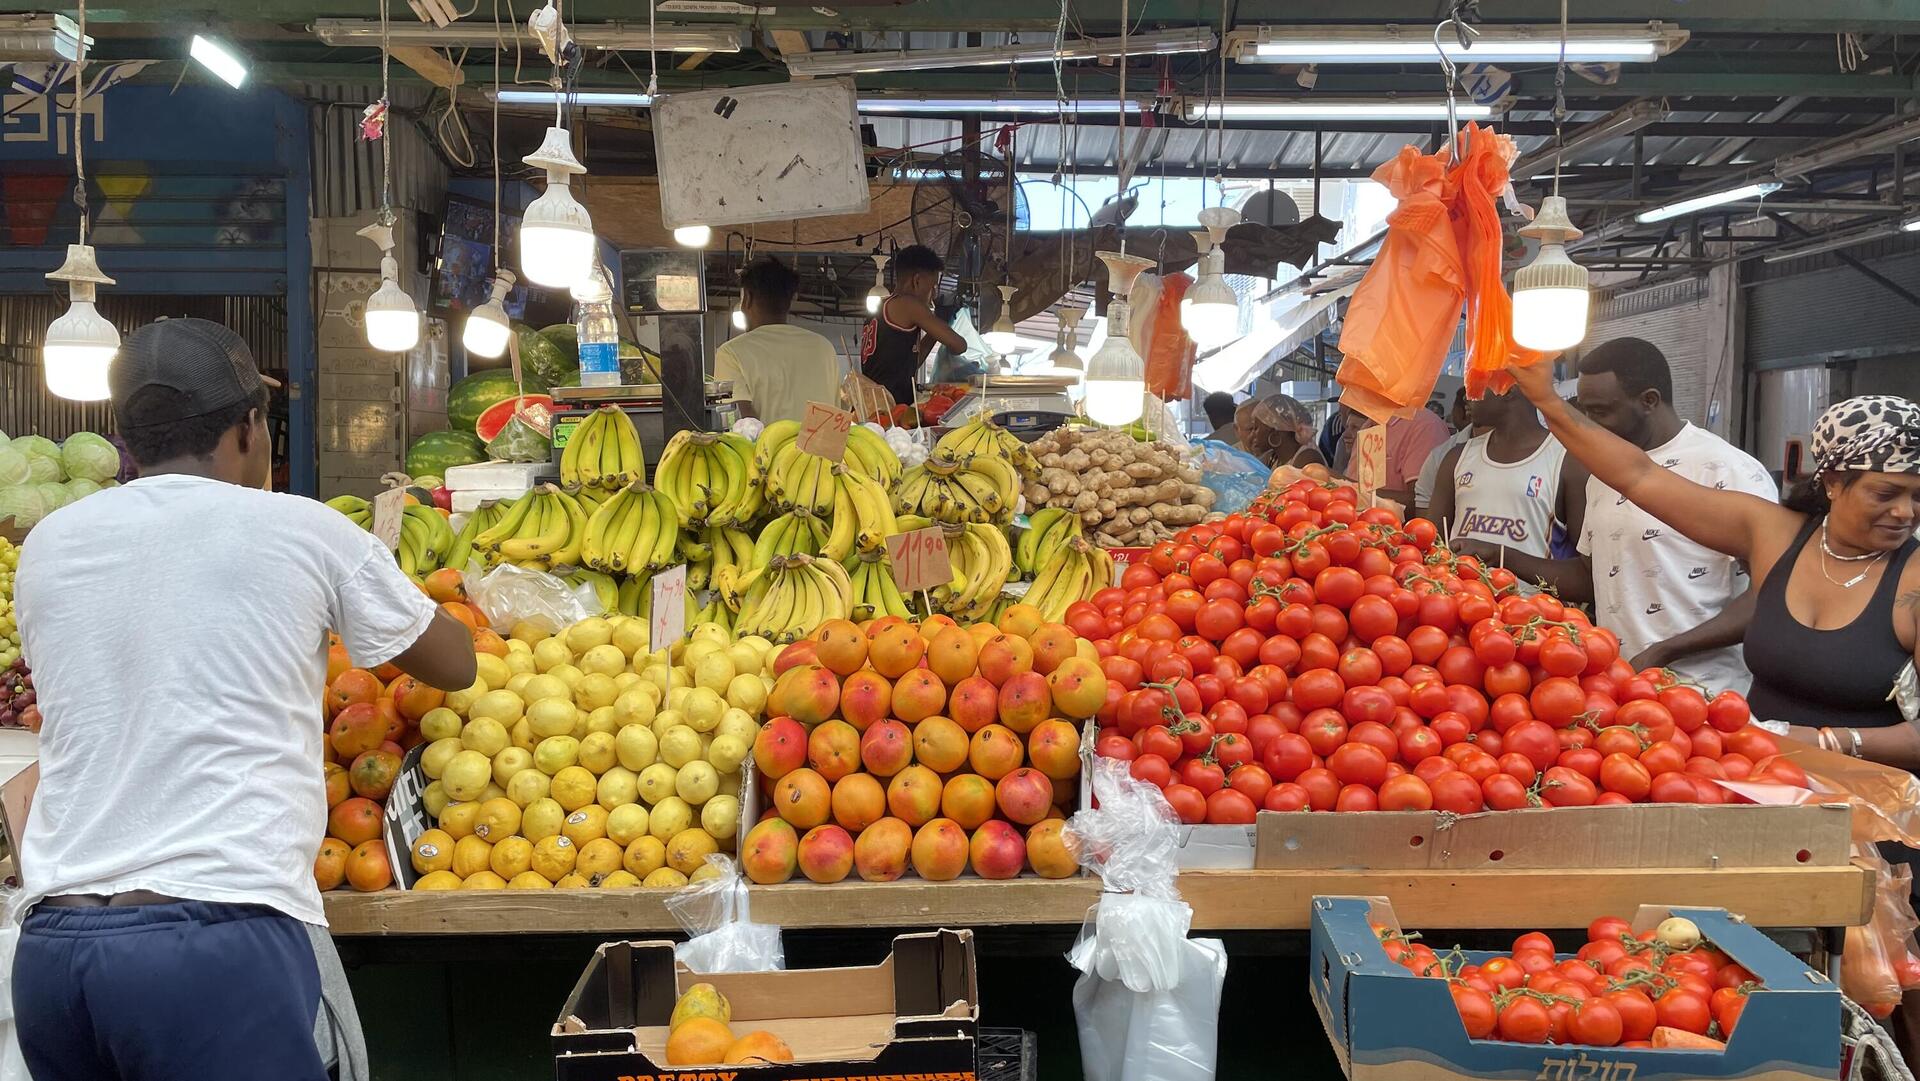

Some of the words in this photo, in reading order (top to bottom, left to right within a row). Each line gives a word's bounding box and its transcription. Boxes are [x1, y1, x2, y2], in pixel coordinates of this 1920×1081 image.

[1458, 507, 1529, 542] LAKERS
[1644, 529, 1661, 537] NIKE
[1693, 567, 1708, 575] NIKE
